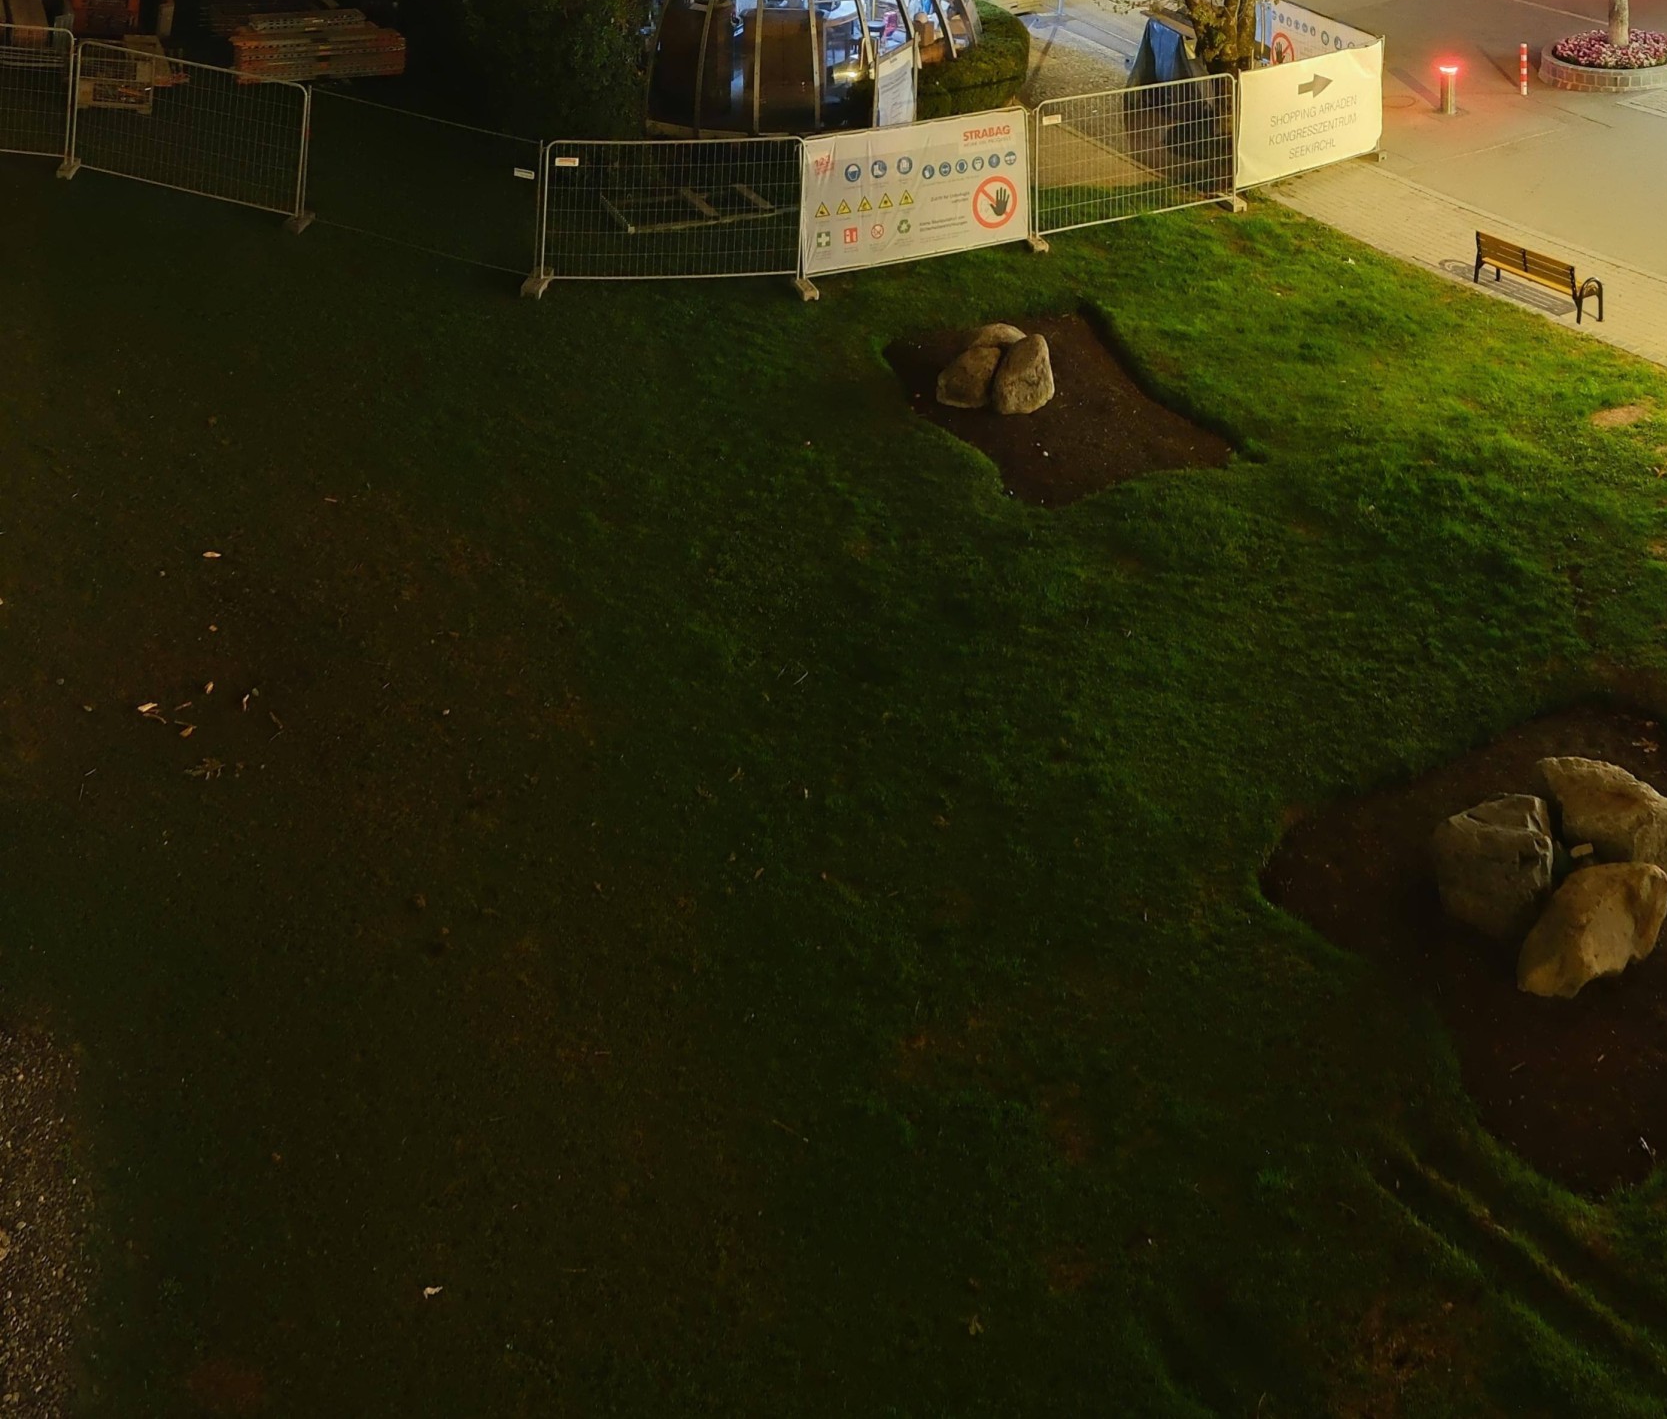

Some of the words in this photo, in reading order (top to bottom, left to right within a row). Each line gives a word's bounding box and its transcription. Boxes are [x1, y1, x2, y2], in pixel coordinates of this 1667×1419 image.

[1270, 105, 1317, 129] SHOPPING
[1318, 95, 1358, 116] ARKADEN
[963, 124, 1011, 142] STRABAG
[1268, 113, 1358, 146] KONGRESSZENTRUM
[1288, 138, 1336, 160] SEEKIRCHL
